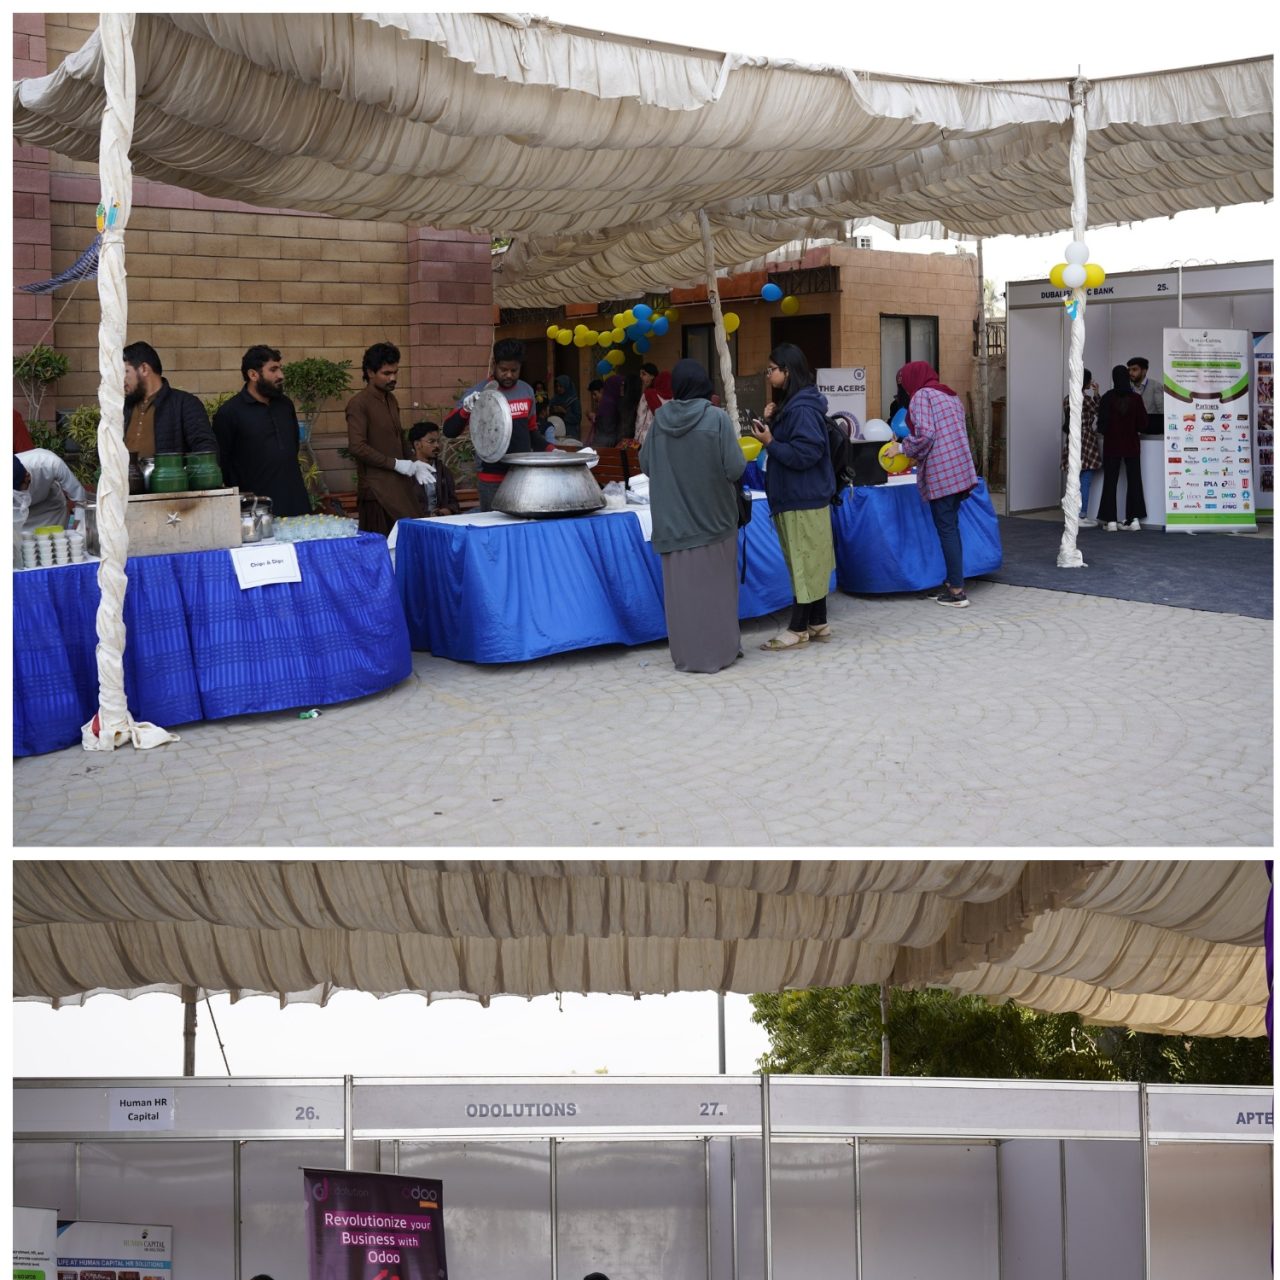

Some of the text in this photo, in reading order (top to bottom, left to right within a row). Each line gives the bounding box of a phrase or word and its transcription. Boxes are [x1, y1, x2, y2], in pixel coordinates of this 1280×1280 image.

[1041, 291, 1062, 299] DUBAI
[1094, 287, 1113, 295] BANK
[120, 1098, 167, 1107] Human HR
[700, 1102, 724, 1116] 27.
[128, 1111, 159, 1121] Capital
[295, 1106, 320, 1121] 26.
[466, 1102, 577, 1118] ODOLUTIONS
[324, 1213, 431, 1231] Revolutionize your
[342, 1232, 418, 1246] Business with
[368, 1251, 400, 1263] Odoo
